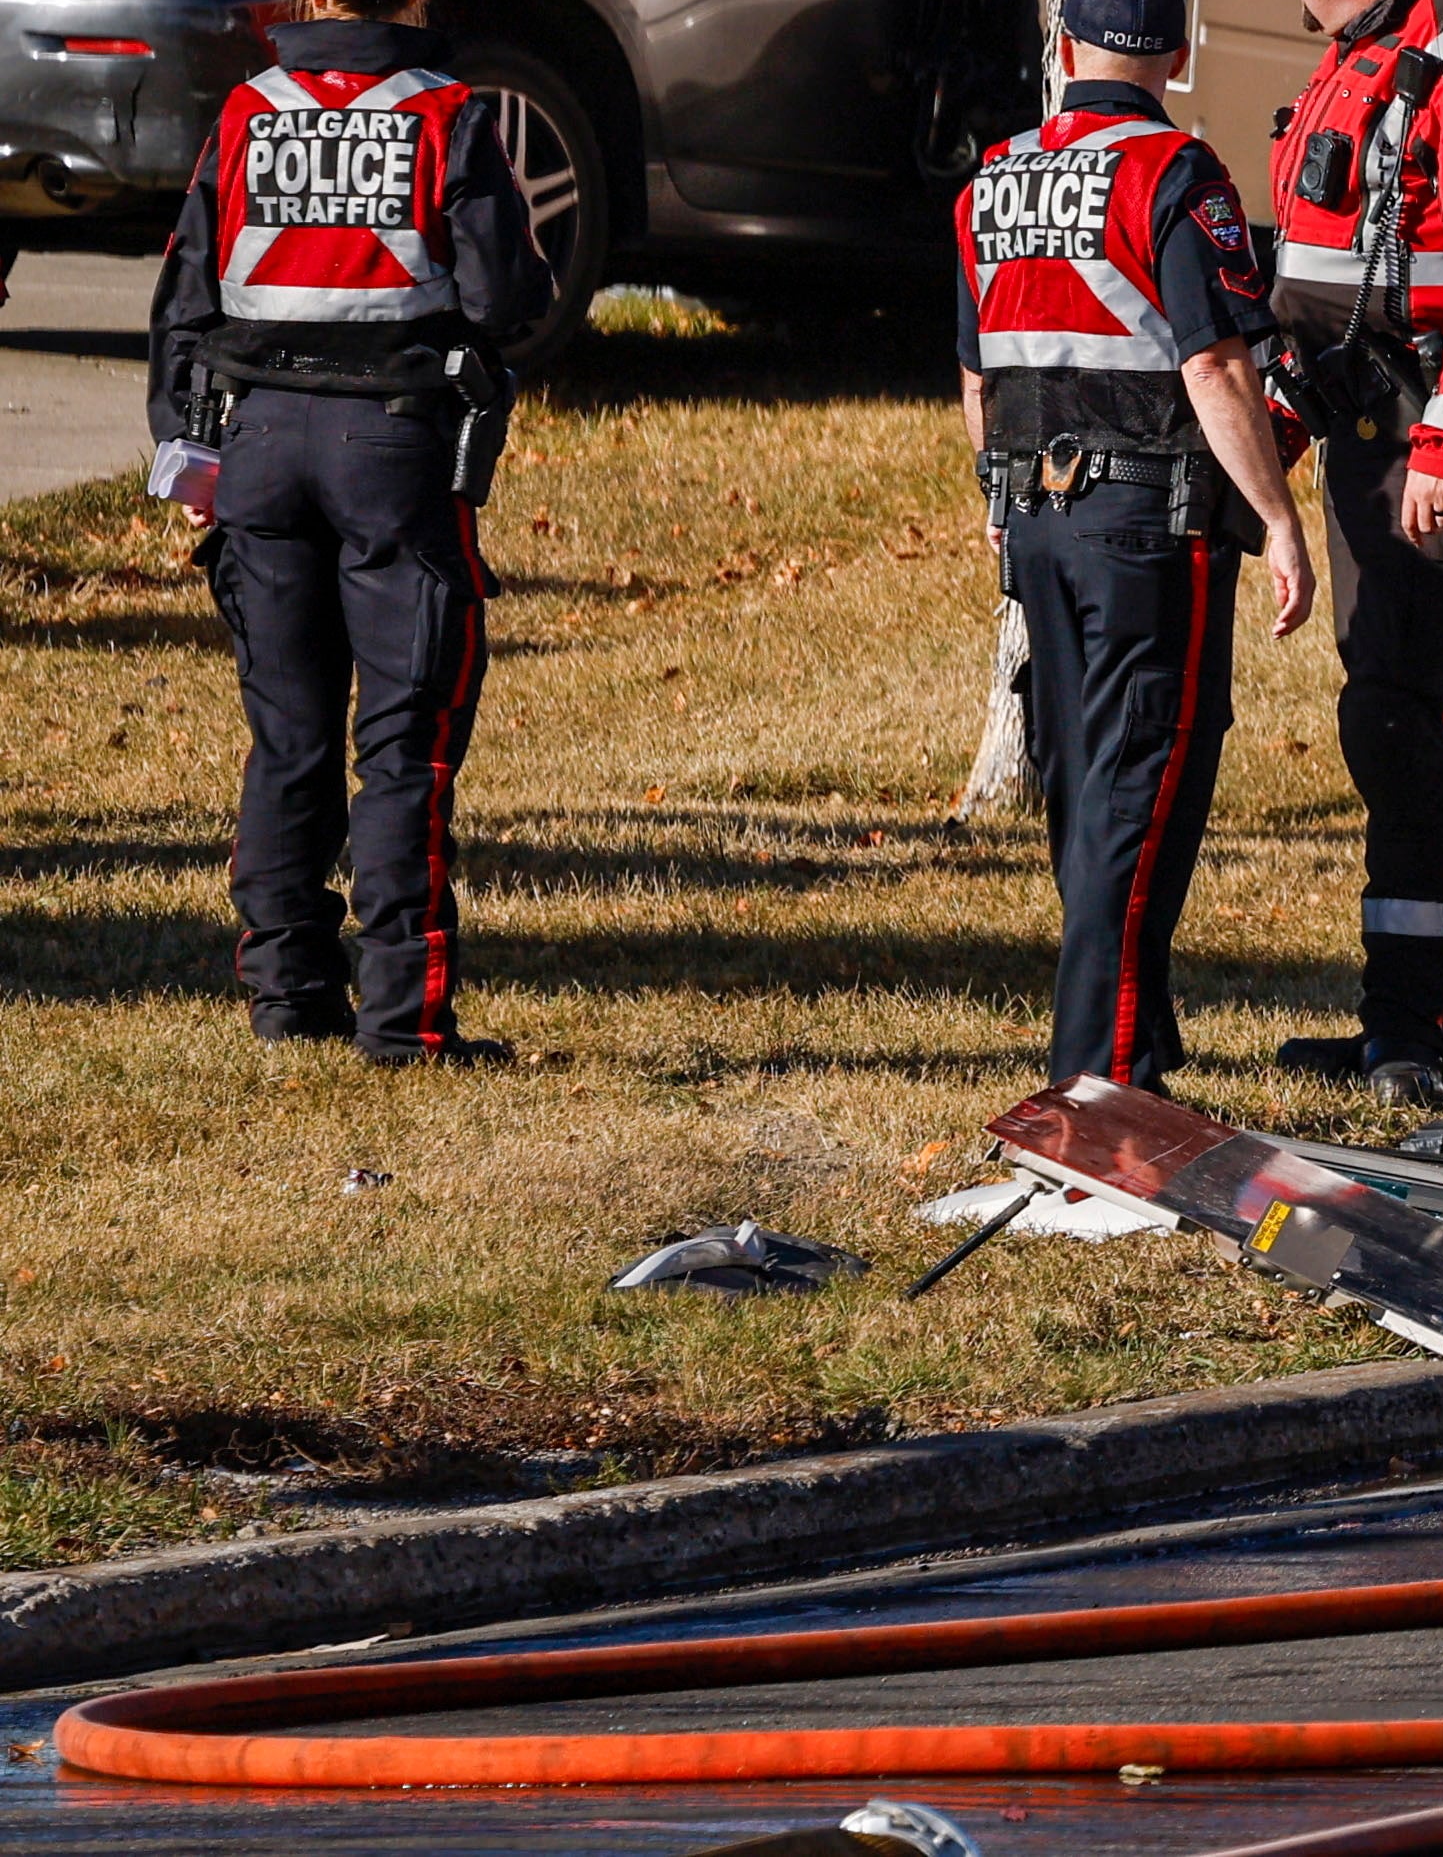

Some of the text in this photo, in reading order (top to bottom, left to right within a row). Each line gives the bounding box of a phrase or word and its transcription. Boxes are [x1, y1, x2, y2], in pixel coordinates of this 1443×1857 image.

[1103, 31, 1164, 50] POLICE
[250, 110, 417, 140] CALGARY
[247, 139, 414, 196] POLICE
[979, 150, 1120, 176] CALGARY
[256, 196, 402, 225] TRAFFIC
[971, 173, 1112, 232] POLICE
[977, 228, 1097, 262] TRAFFIC
